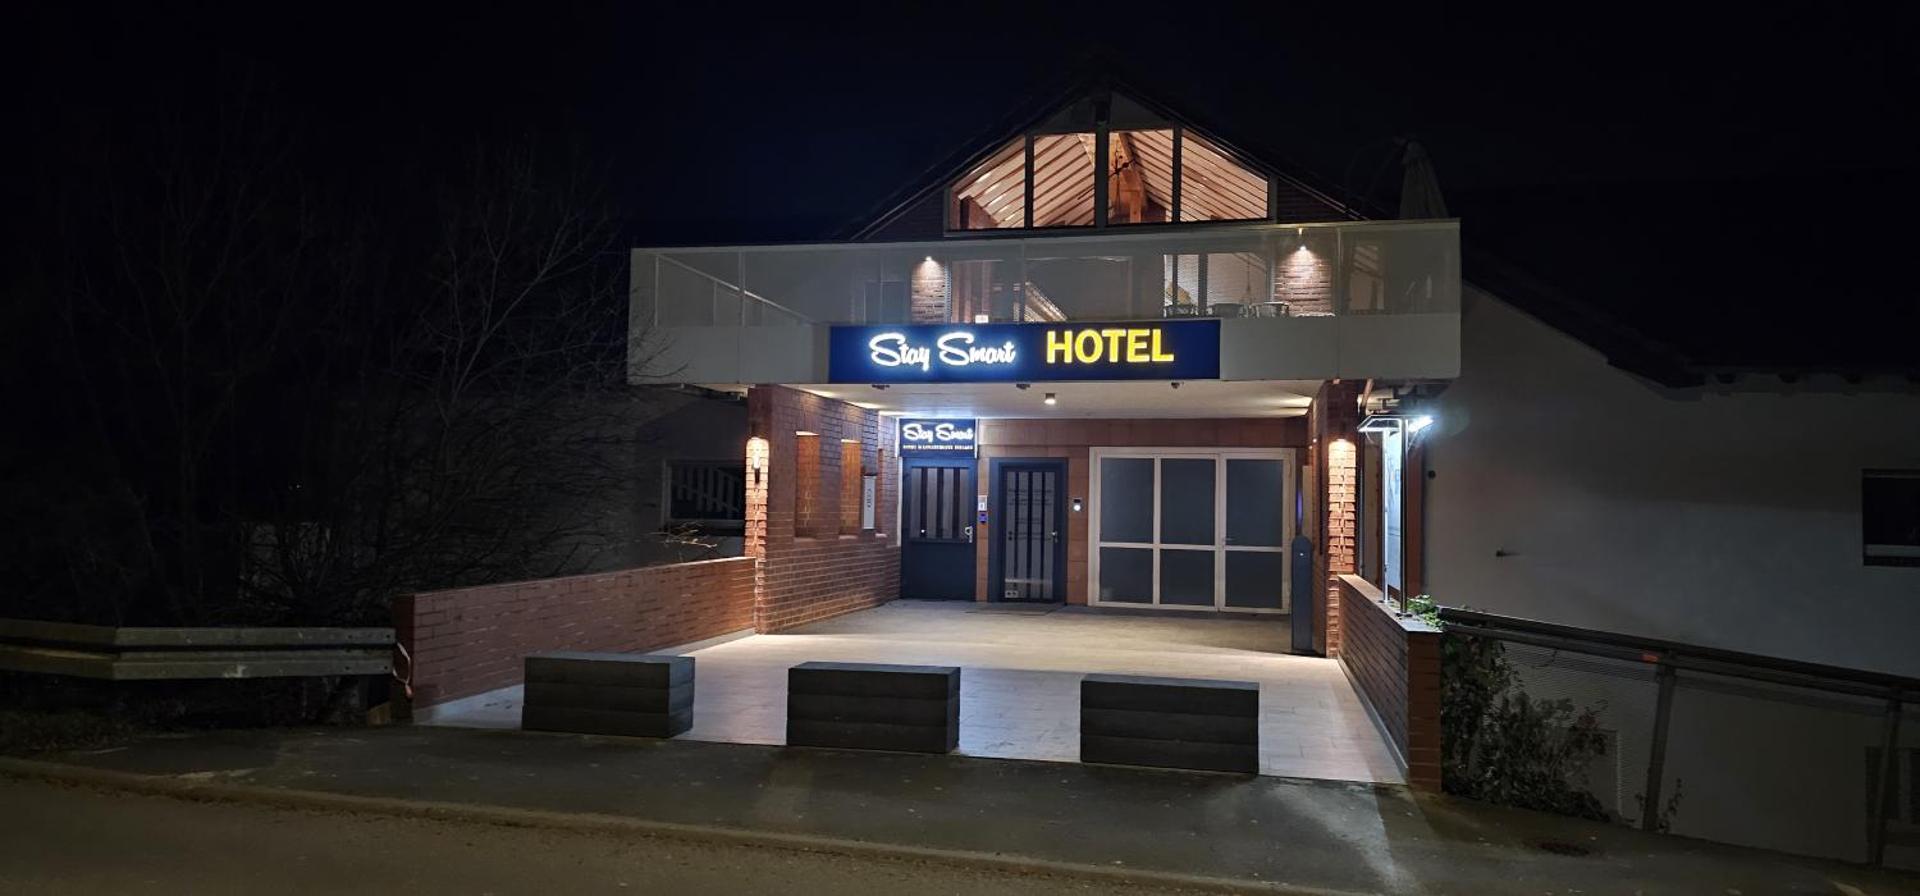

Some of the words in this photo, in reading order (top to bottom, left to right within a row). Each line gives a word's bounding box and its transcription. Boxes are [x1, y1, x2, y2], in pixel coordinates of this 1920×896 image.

[869, 332, 930, 371] Stay
[936, 332, 1016, 366] Smart
[1045, 328, 1174, 364] HOTEL
